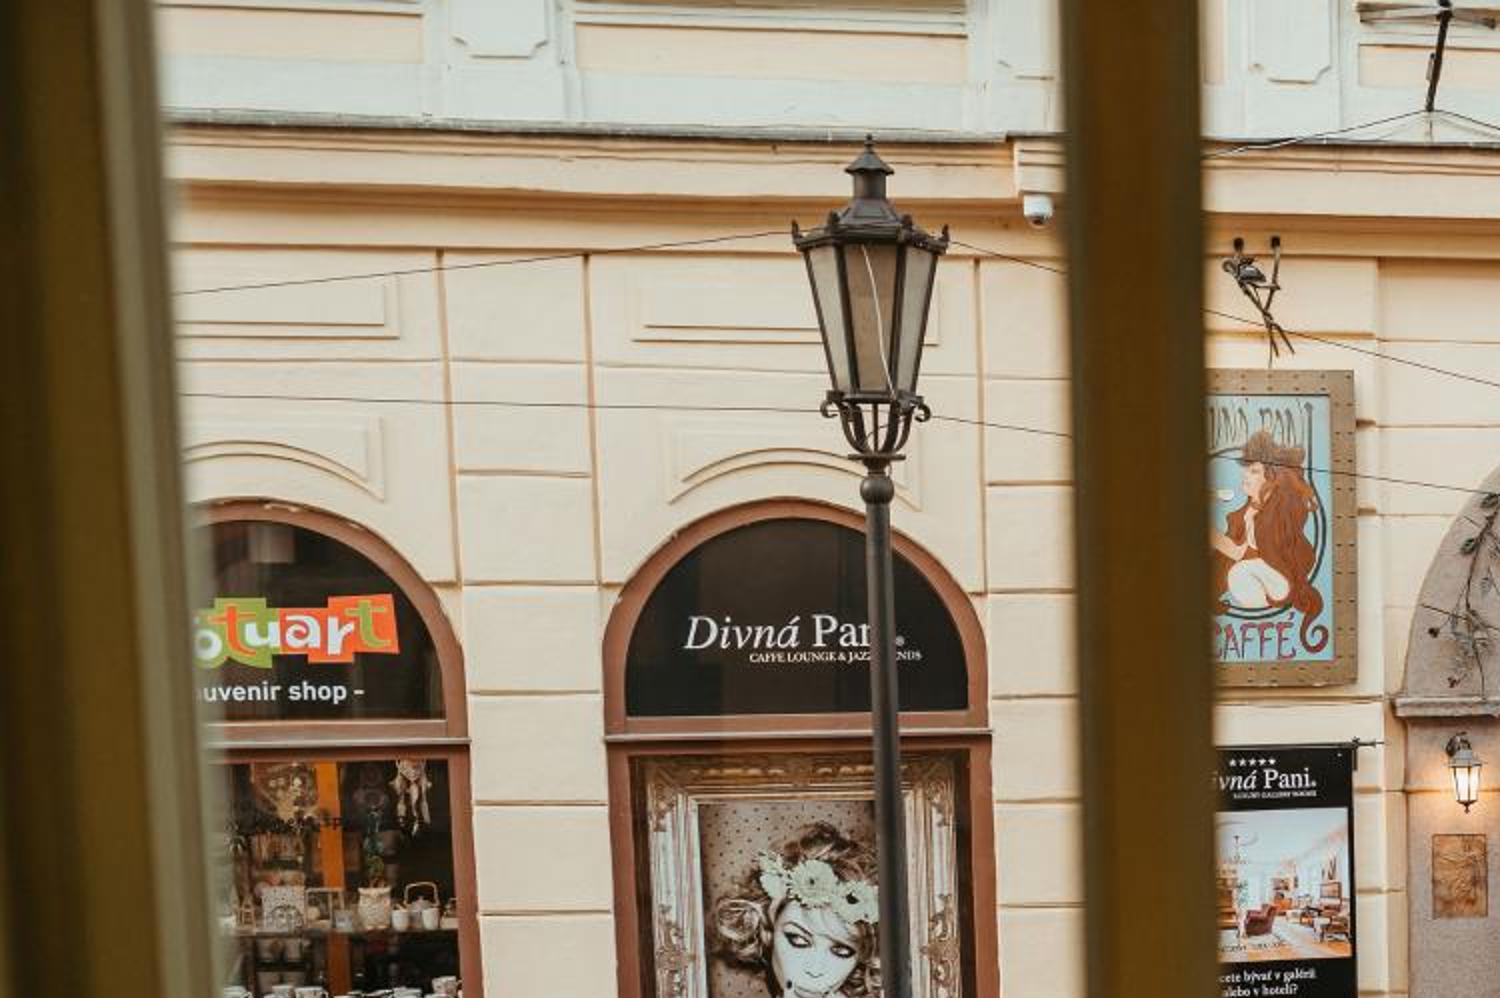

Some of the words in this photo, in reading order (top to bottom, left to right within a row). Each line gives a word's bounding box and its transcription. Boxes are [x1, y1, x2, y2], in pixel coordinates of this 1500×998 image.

[684, 615, 801, 649] Divná
[787, 651, 837, 663] LOUNGE
[202, 680, 282, 701] uvenir
[287, 680, 347, 705] shop
